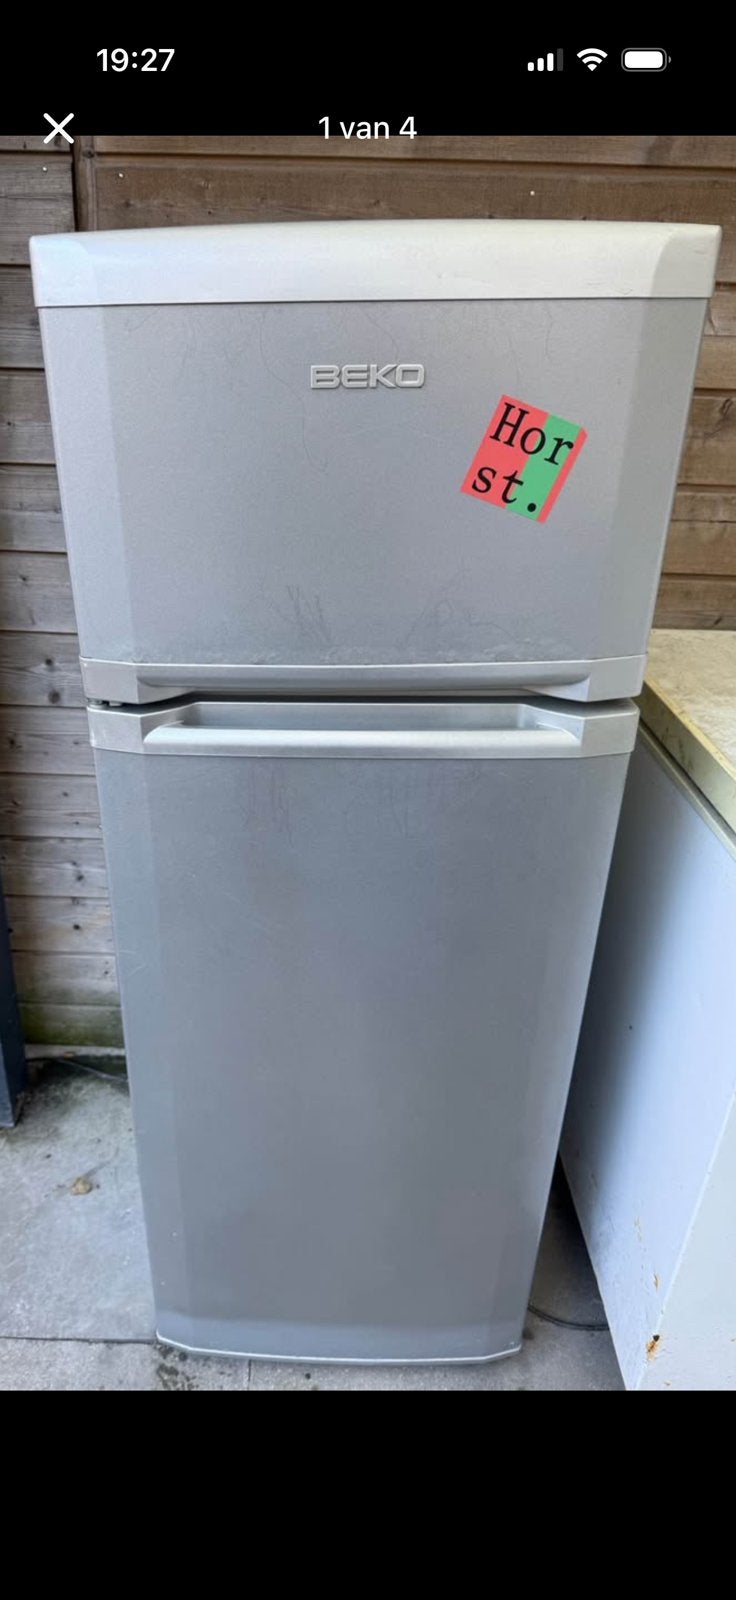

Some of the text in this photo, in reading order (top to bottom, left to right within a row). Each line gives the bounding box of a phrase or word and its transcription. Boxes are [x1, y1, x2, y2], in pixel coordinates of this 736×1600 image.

[310, 363, 425, 390] BEKO
[489, 402, 575, 465] Hor
[471, 466, 538, 513] st.
